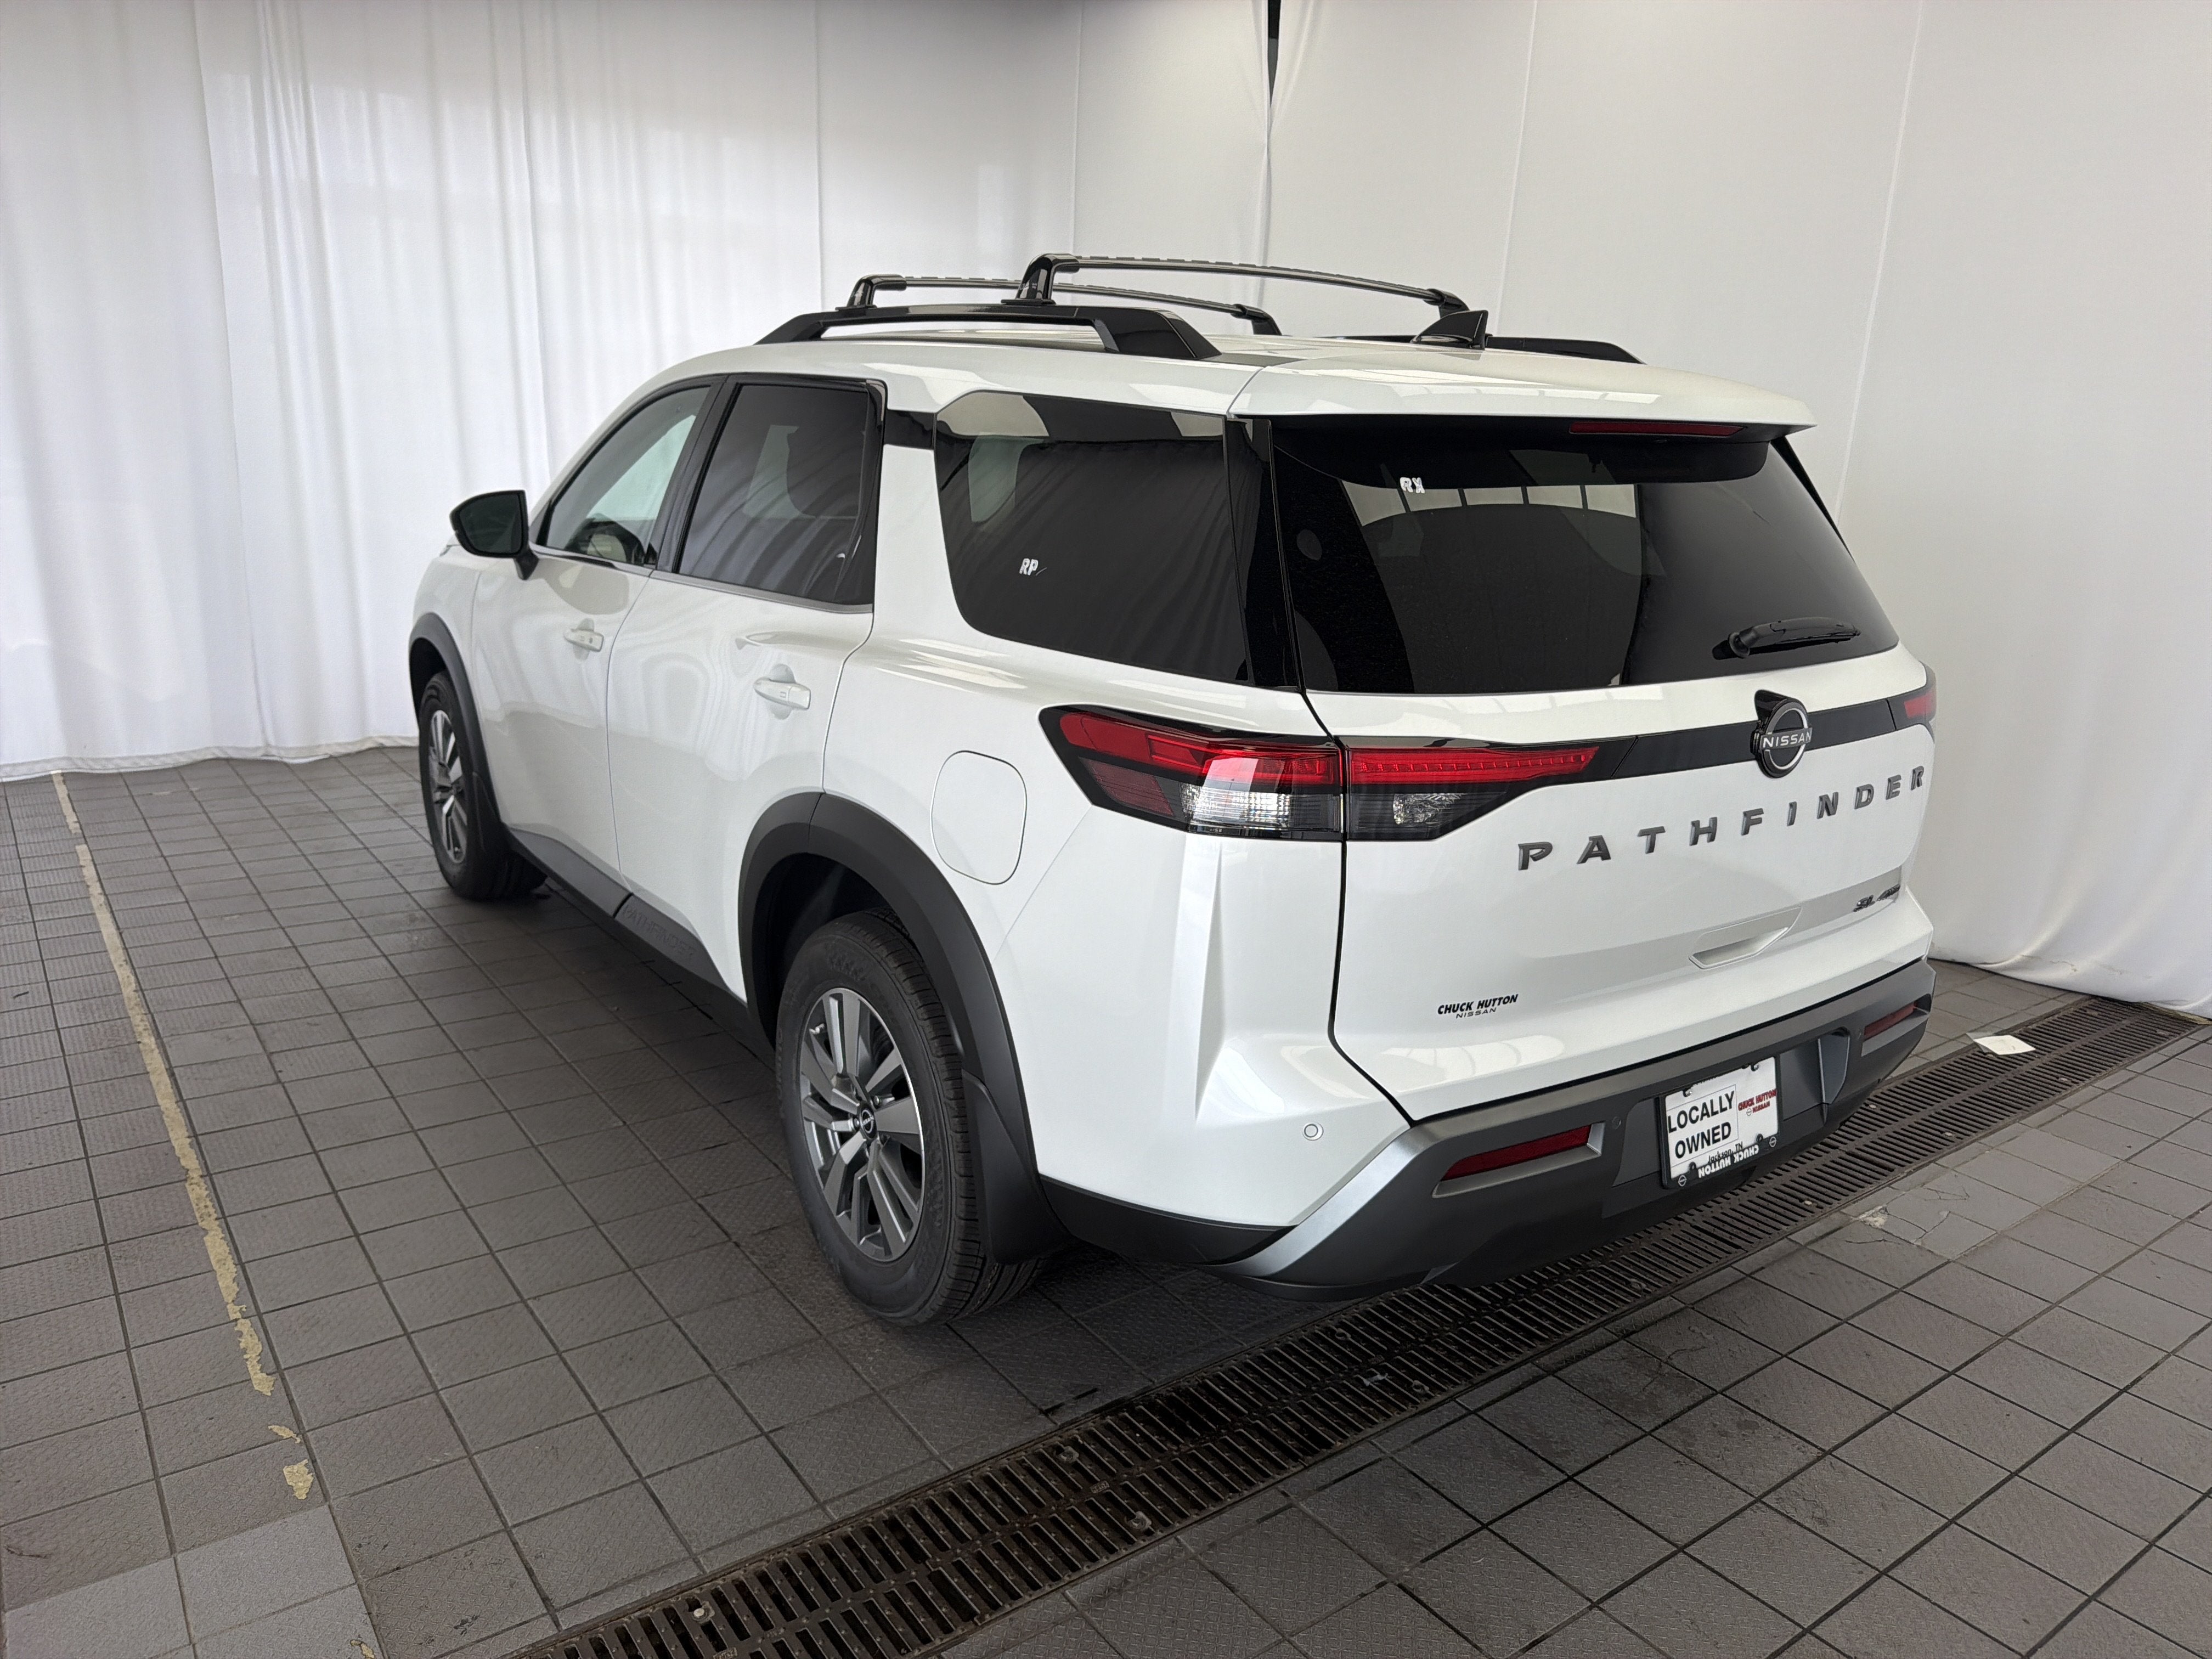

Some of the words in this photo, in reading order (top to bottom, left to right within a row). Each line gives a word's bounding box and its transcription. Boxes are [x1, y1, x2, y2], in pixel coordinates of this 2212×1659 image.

[1019, 558, 1039, 575] RP
[1763, 731, 1811, 748] NISSAN
[1518, 765, 1925, 871] PATHFINDER
[1437, 1001, 1474, 1015] CHUCK
[1476, 994, 1519, 1010] HUTTON
[1455, 1007, 1497, 1019] NISSAN
[1738, 1097, 1755, 1111] CHUCK
[1756, 1088, 1778, 1104] HUTTON
[1668, 1090, 1735, 1134] LOCALLY
[1675, 1121, 1731, 1159] OWNED
[1735, 1141, 1743, 1152] TN
[1733, 1144, 1759, 1164] CHUCK
[1698, 1155, 1731, 1179] HUTTON
